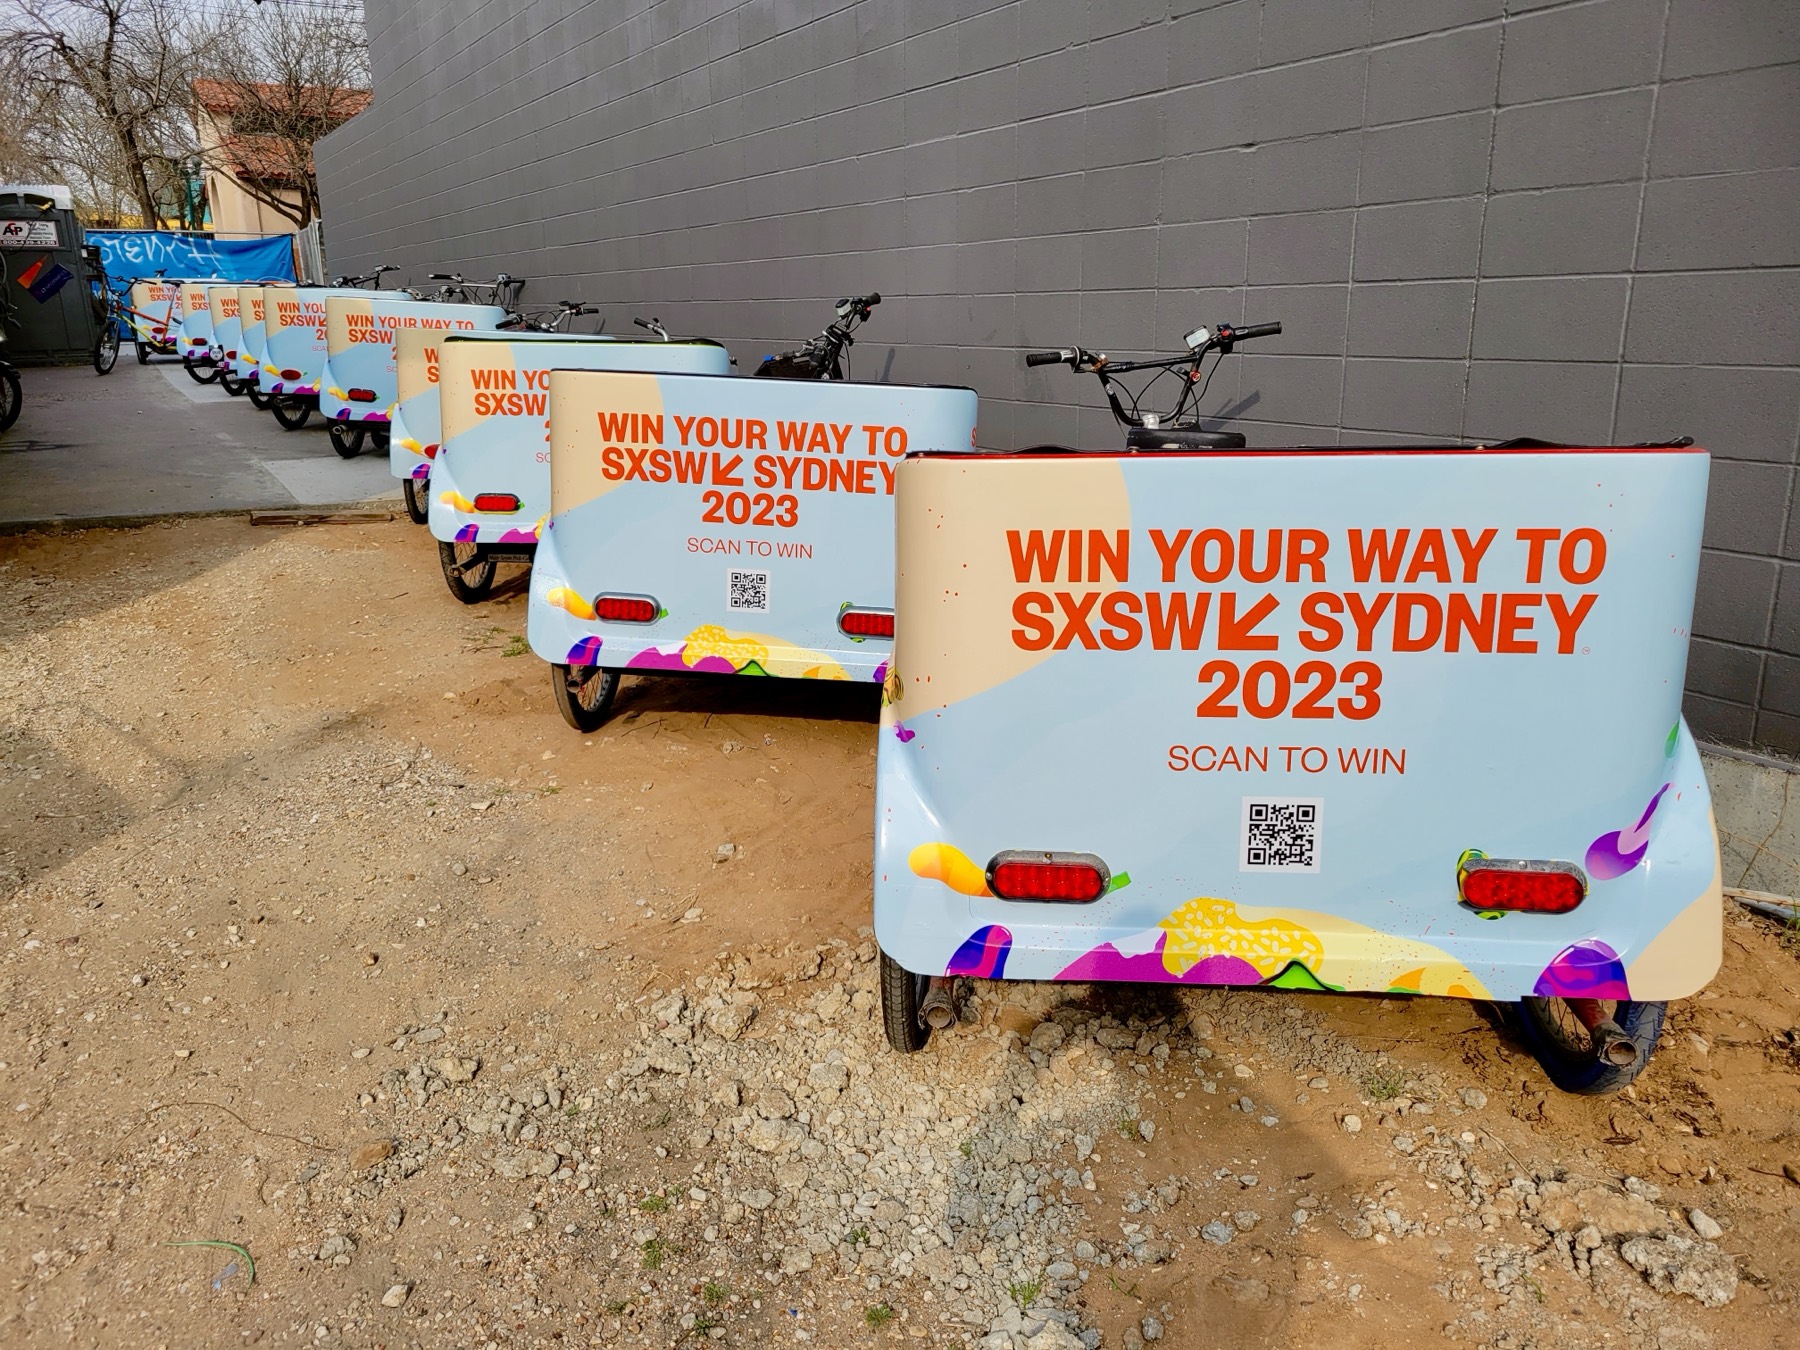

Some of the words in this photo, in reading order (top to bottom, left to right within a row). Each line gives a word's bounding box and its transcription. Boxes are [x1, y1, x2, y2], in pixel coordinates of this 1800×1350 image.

[192, 302, 209, 310] SXS
[251, 300, 264, 309] WI
[277, 302, 300, 313] WIN
[303, 303, 326, 314] YOU
[280, 315, 315, 327] SXSW
[346, 315, 374, 328] WIN
[378, 316, 417, 329] YOUR
[421, 319, 451, 330] WAY
[348, 328, 392, 344] SXSW
[470, 369, 516, 390] WIN
[522, 370, 550, 390] YO
[473, 392, 546, 416] SXSW
[597, 411, 663, 445] WIN
[673, 415, 768, 450] YOUR
[776, 420, 853, 454] WAY
[862, 425, 908, 457] TO
[601, 446, 707, 484] SXSW
[753, 454, 896, 495] SYDNEY
[701, 490, 799, 527] 2023
[687, 536, 741, 555] SCAN
[745, 539, 773, 557] TO
[776, 542, 813, 560] WIN
[1006, 529, 1129, 584] WIN
[1148, 528, 1329, 584] YOUR
[1347, 528, 1498, 583] WAY
[1515, 527, 1608, 585] TO
[1011, 591, 1212, 652] SXSW
[1297, 591, 1598, 655] SYDNEY
[1196, 660, 1383, 721] 2023
[1167, 744, 1269, 773] SCAN
[1278, 745, 1329, 774] TO
[1337, 746, 1407, 775] WIN
